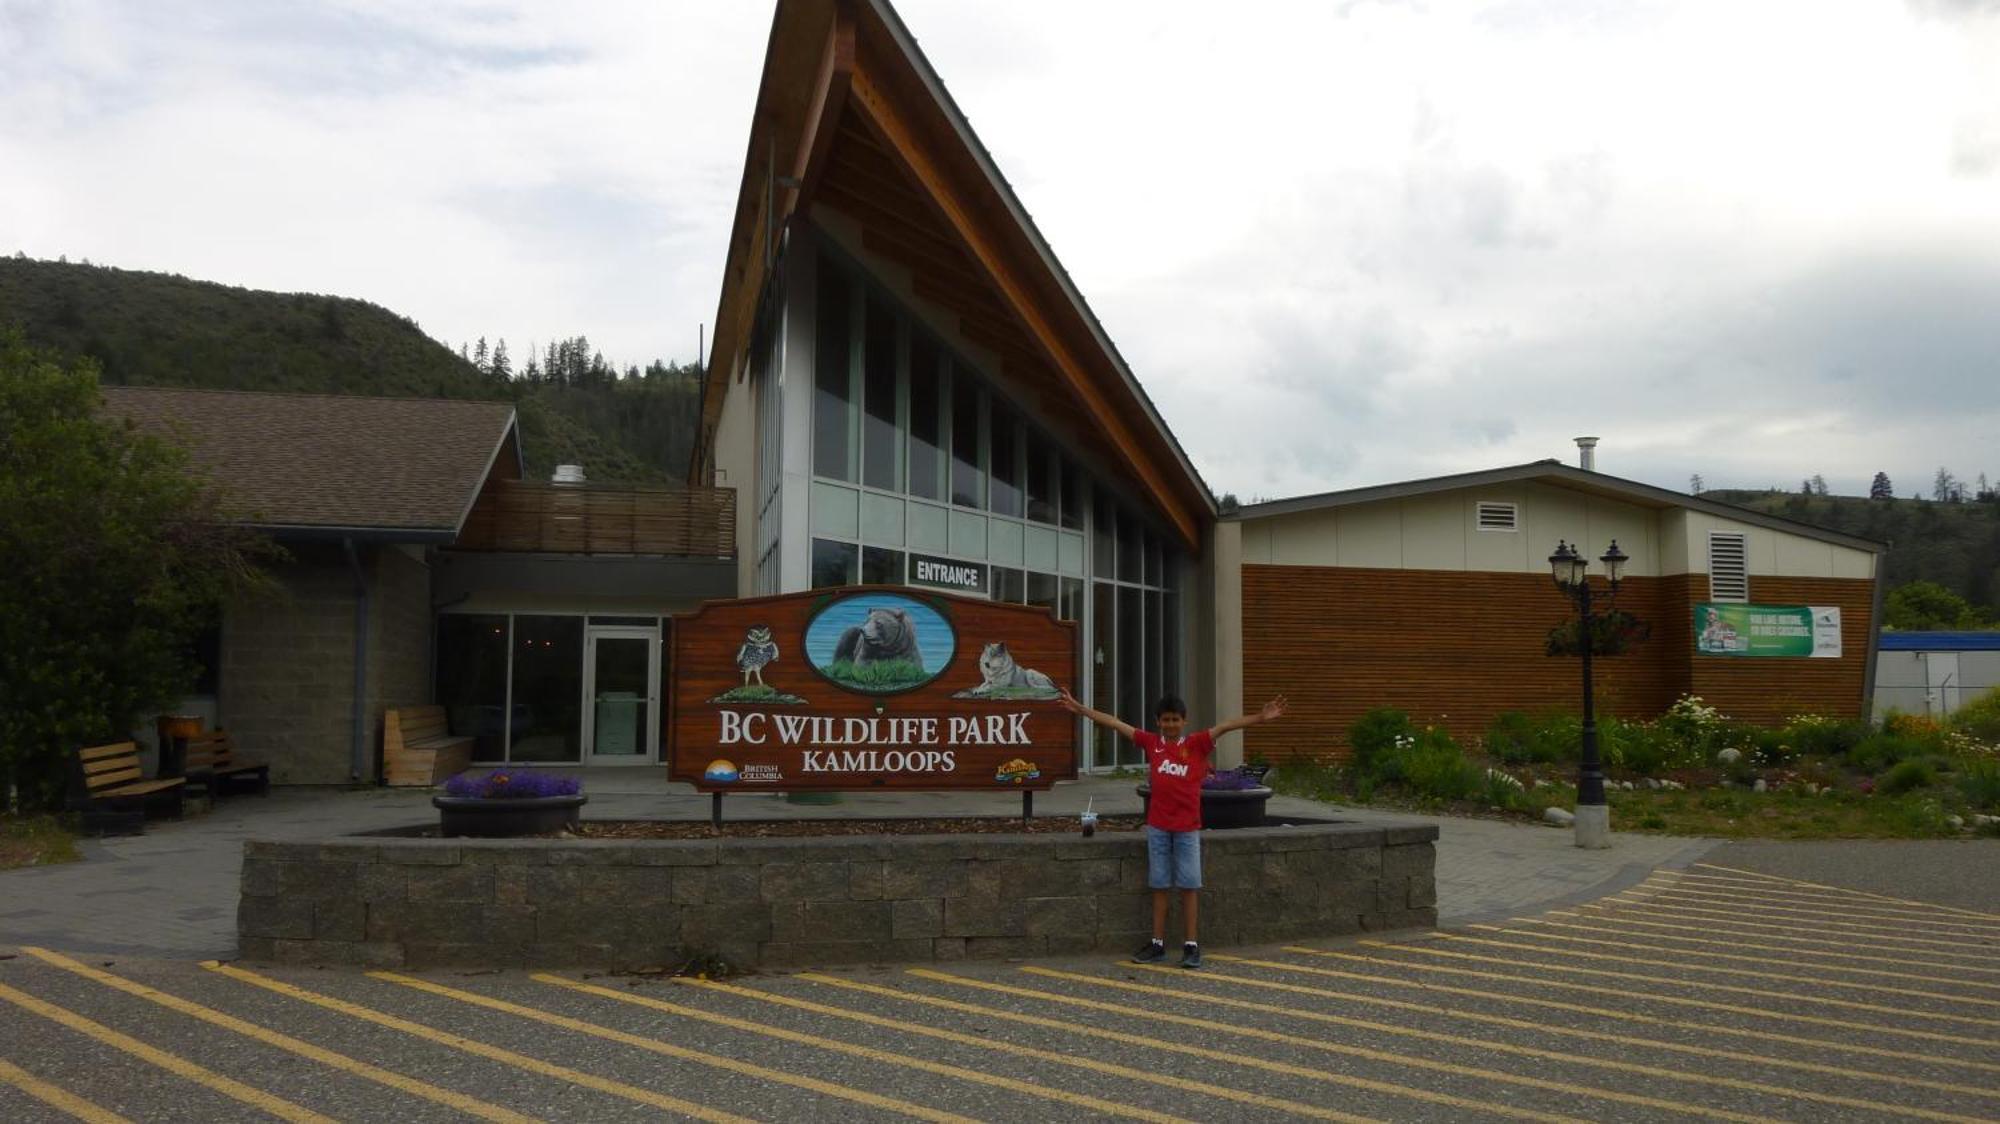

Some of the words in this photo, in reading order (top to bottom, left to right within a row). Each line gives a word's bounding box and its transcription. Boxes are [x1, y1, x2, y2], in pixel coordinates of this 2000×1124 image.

[917, 560, 978, 587] ENTRANCE
[719, 710, 766, 744] BC
[772, 714, 939, 744] WILDLIFE
[947, 712, 1032, 744] PARK
[744, 764, 779, 773] BRITISH
[802, 751, 956, 772] KAMLOOPS
[1157, 759, 1188, 777] AON
[738, 772, 784, 780] COLUMBIA
